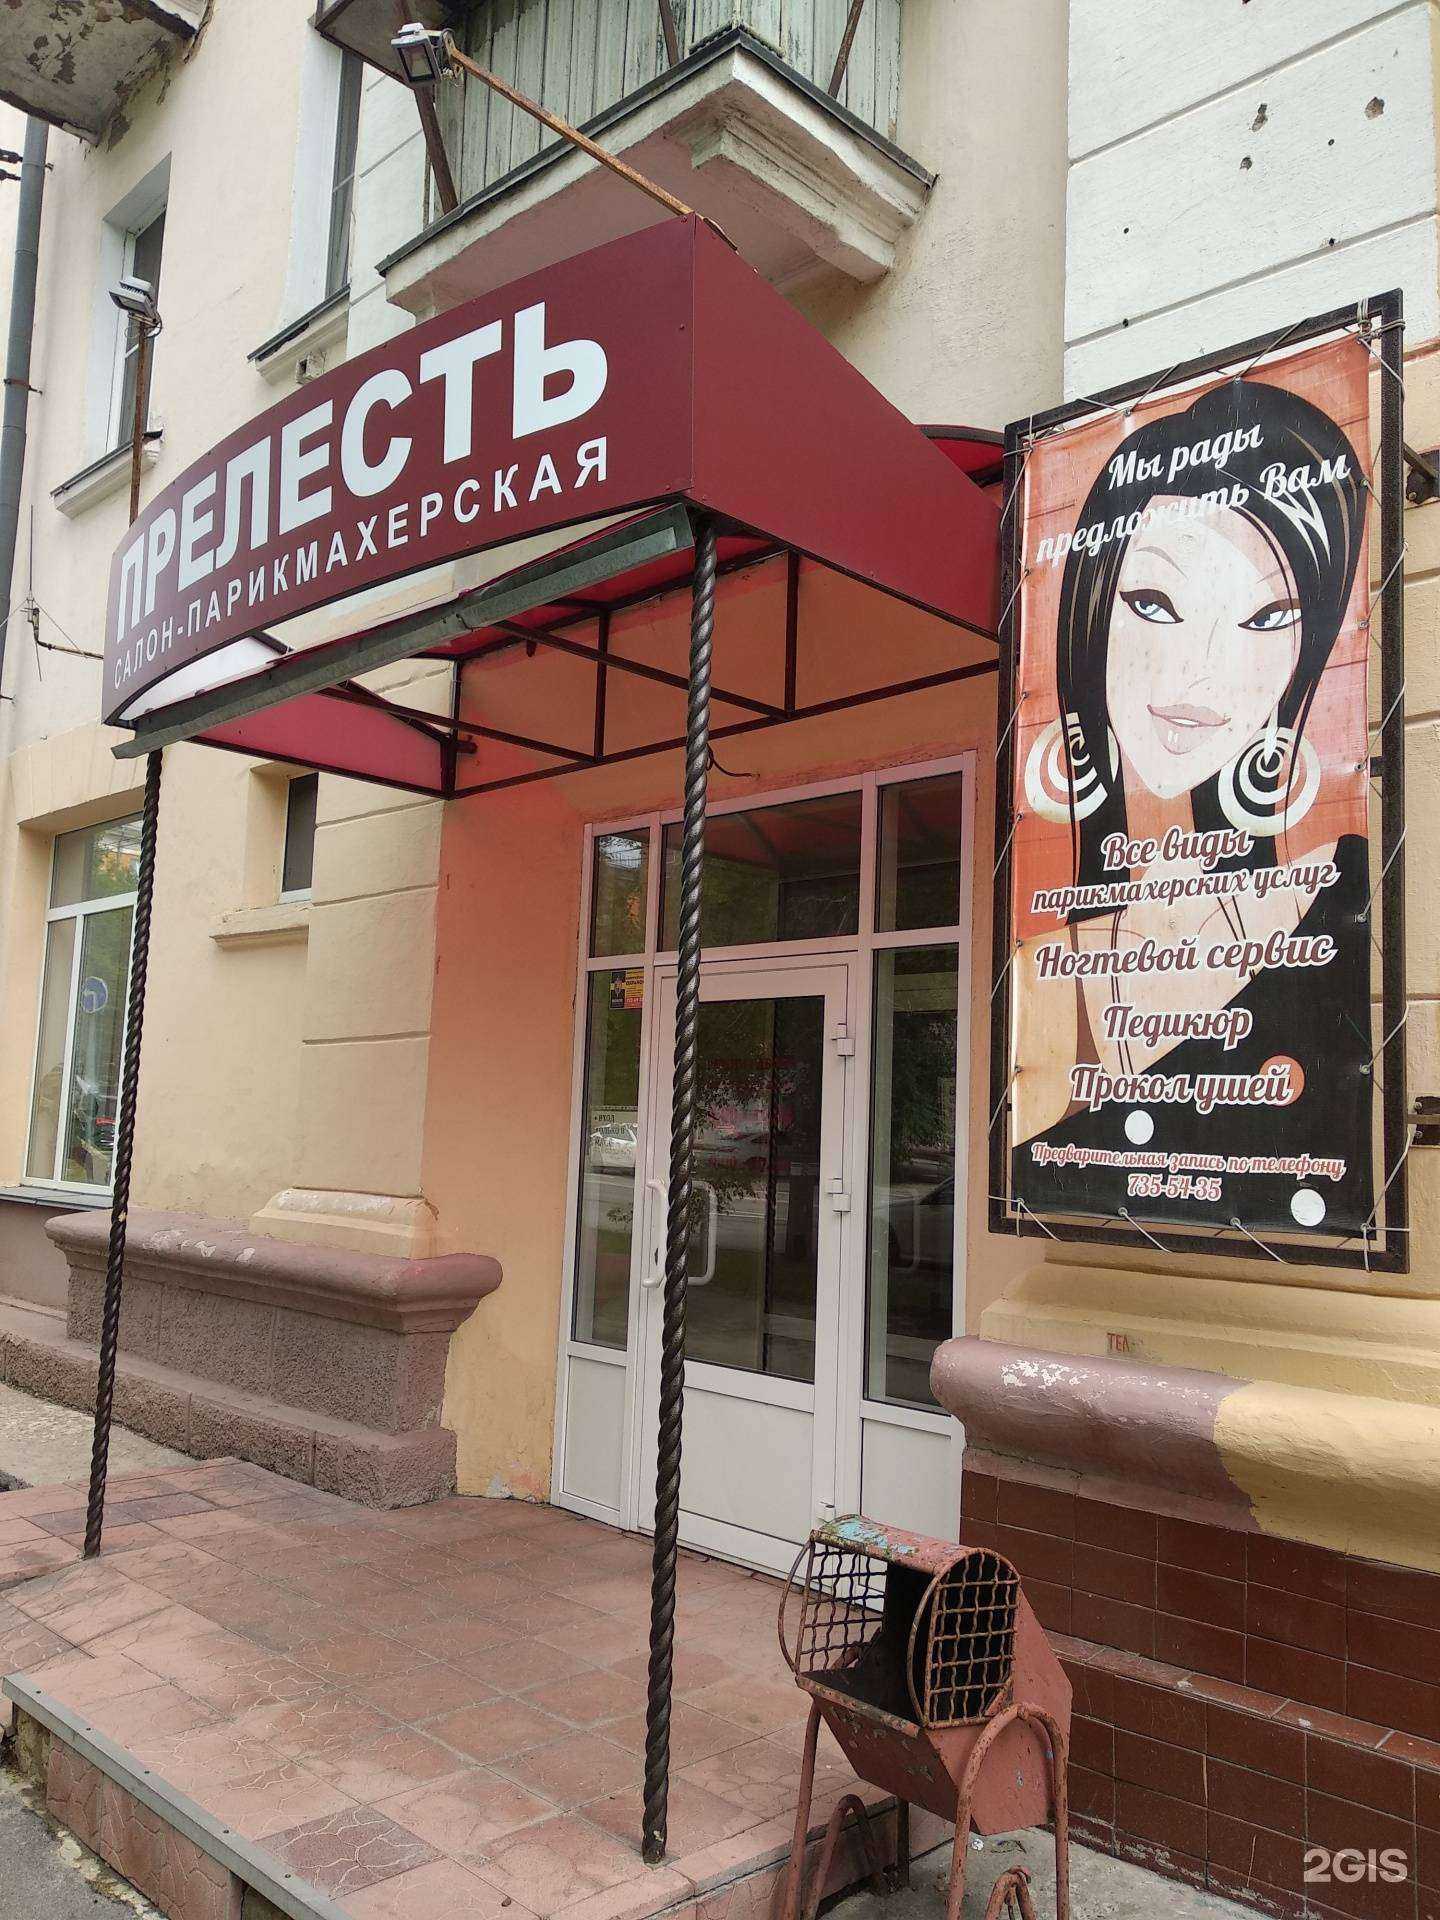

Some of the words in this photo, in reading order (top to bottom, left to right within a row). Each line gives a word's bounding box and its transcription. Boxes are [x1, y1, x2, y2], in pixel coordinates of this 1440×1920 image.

[116, 301, 608, 644] ПРЕЛЕСТЬ
[1108, 449, 1164, 490] Мы
[1167, 424, 1264, 484] рады
[1260, 454, 1351, 501] Вам
[113, 436, 608, 690] САЛОН-ПАРИКМАХЕРСКАЯ
[1101, 831, 1160, 871] Все
[1162, 825, 1254, 870] виды
[1031, 872, 1249, 919] парикмахерских
[1253, 861, 1341, 900] услуг
[1036, 937, 1200, 980] Ногтевой
[1206, 930, 1338, 979] сервис
[1103, 1003, 1252, 1050] Педикюр
[1071, 1062, 1191, 1112] Прокол
[1194, 1064, 1294, 1113] ушей
[1032, 1142, 1167, 1171] Предварительная
[1168, 1152, 1225, 1173] запись
[1226, 1154, 1250, 1174] по
[1250, 1153, 1346, 1181] телефону
[1127, 1173, 1222, 1200] 735-54-35
